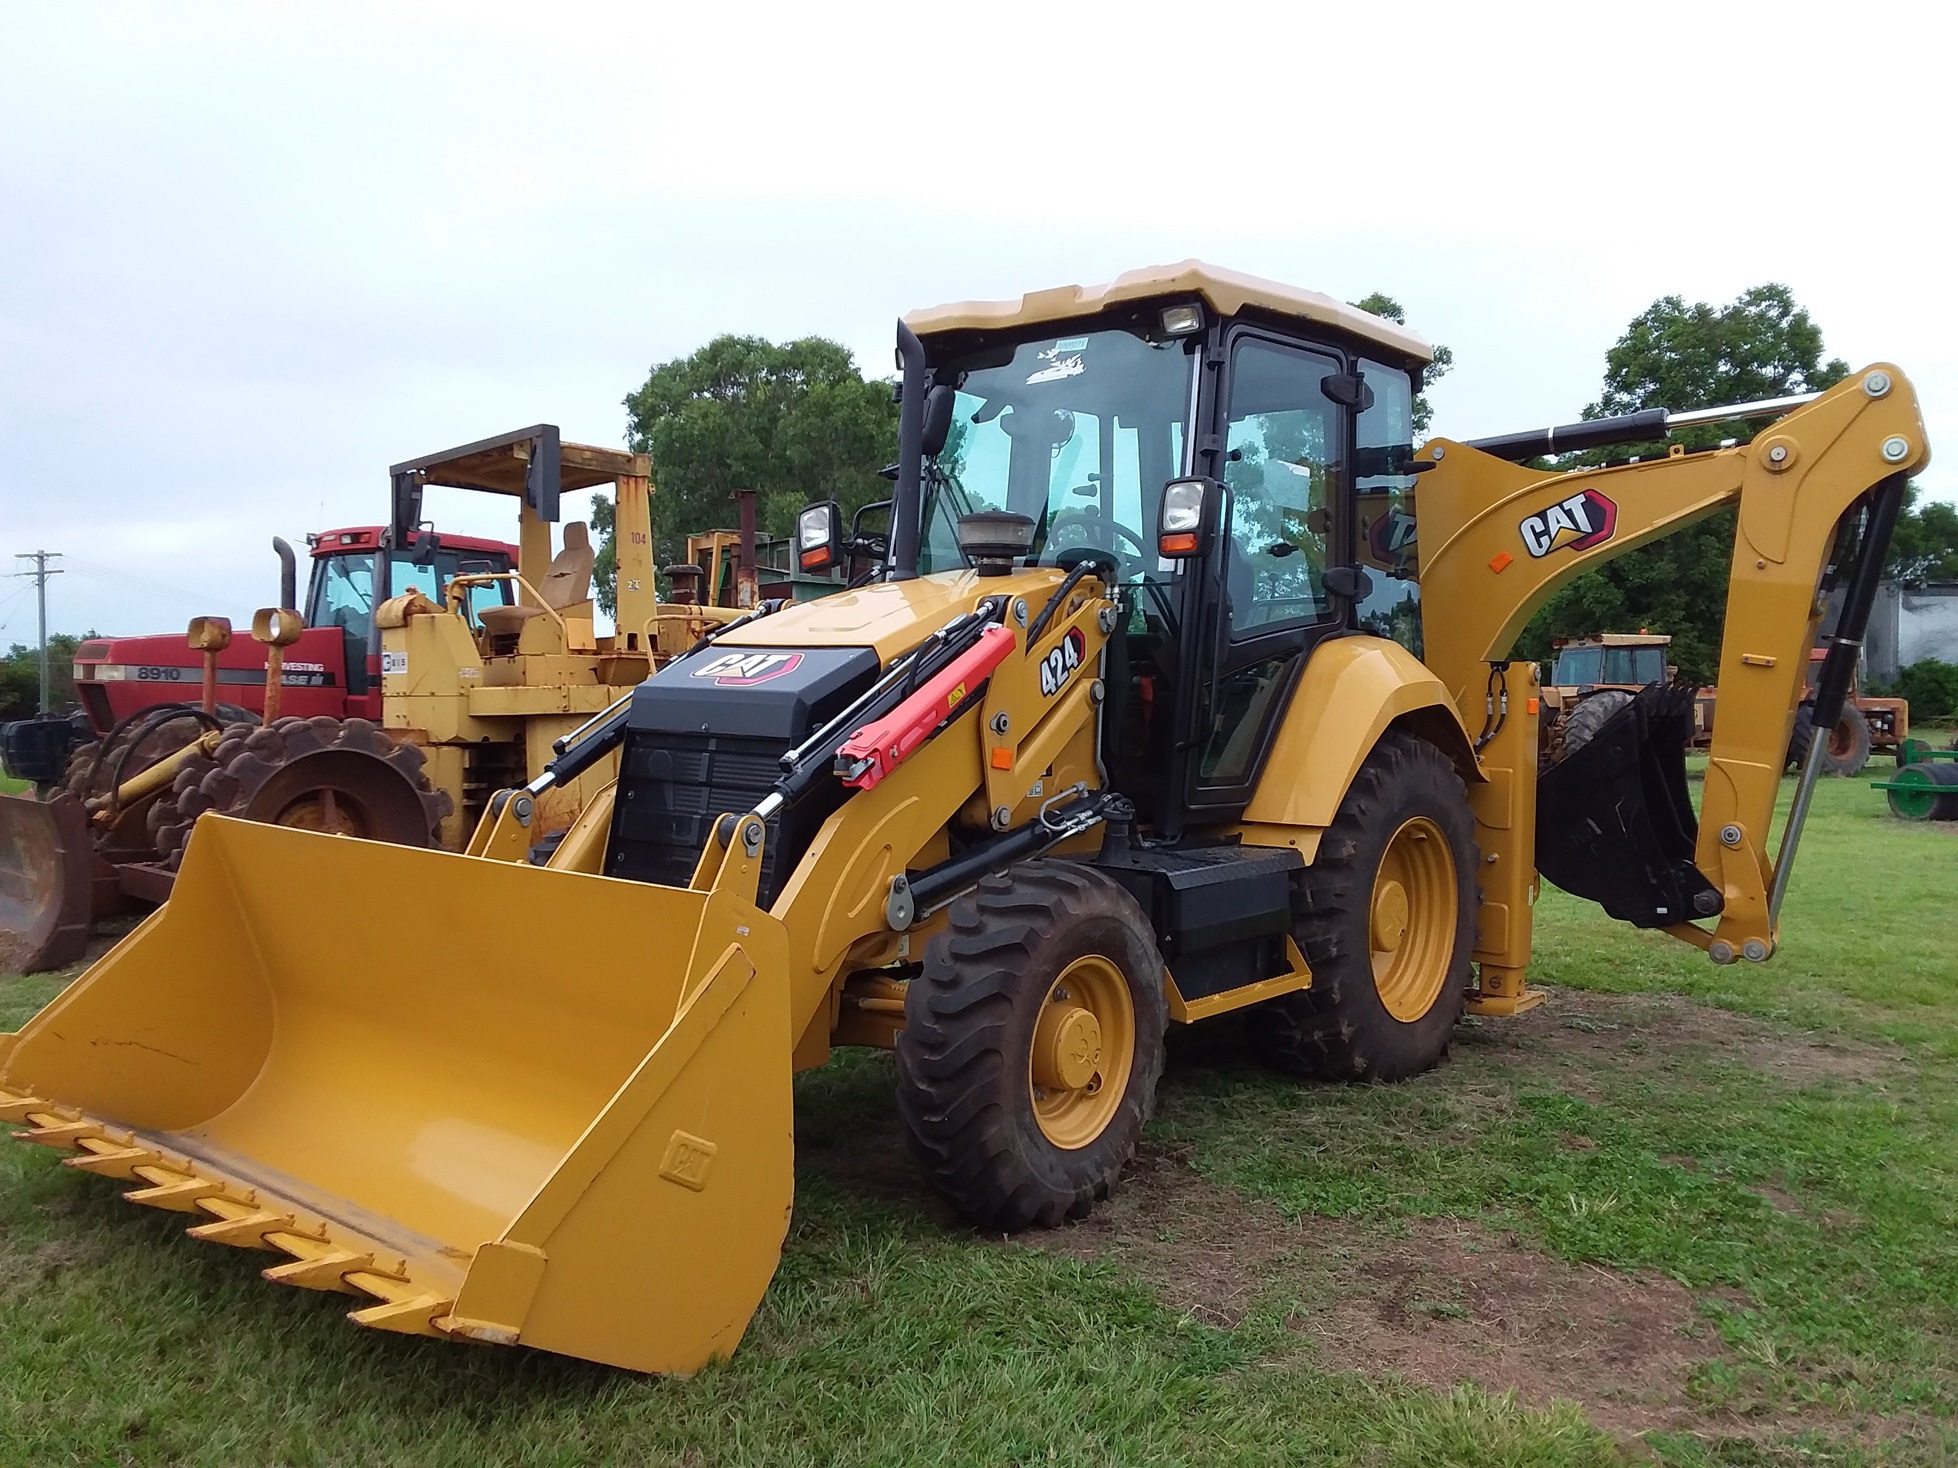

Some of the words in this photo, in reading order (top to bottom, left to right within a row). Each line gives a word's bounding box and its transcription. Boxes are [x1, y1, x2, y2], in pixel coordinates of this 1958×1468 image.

[1520, 493, 1594, 557] CAT
[631, 532, 647, 545] 104
[137, 667, 180, 680] 8910
[694, 653, 793, 678] CAT
[1041, 634, 1079, 695] 424
[281, 674, 309, 685] ASE
